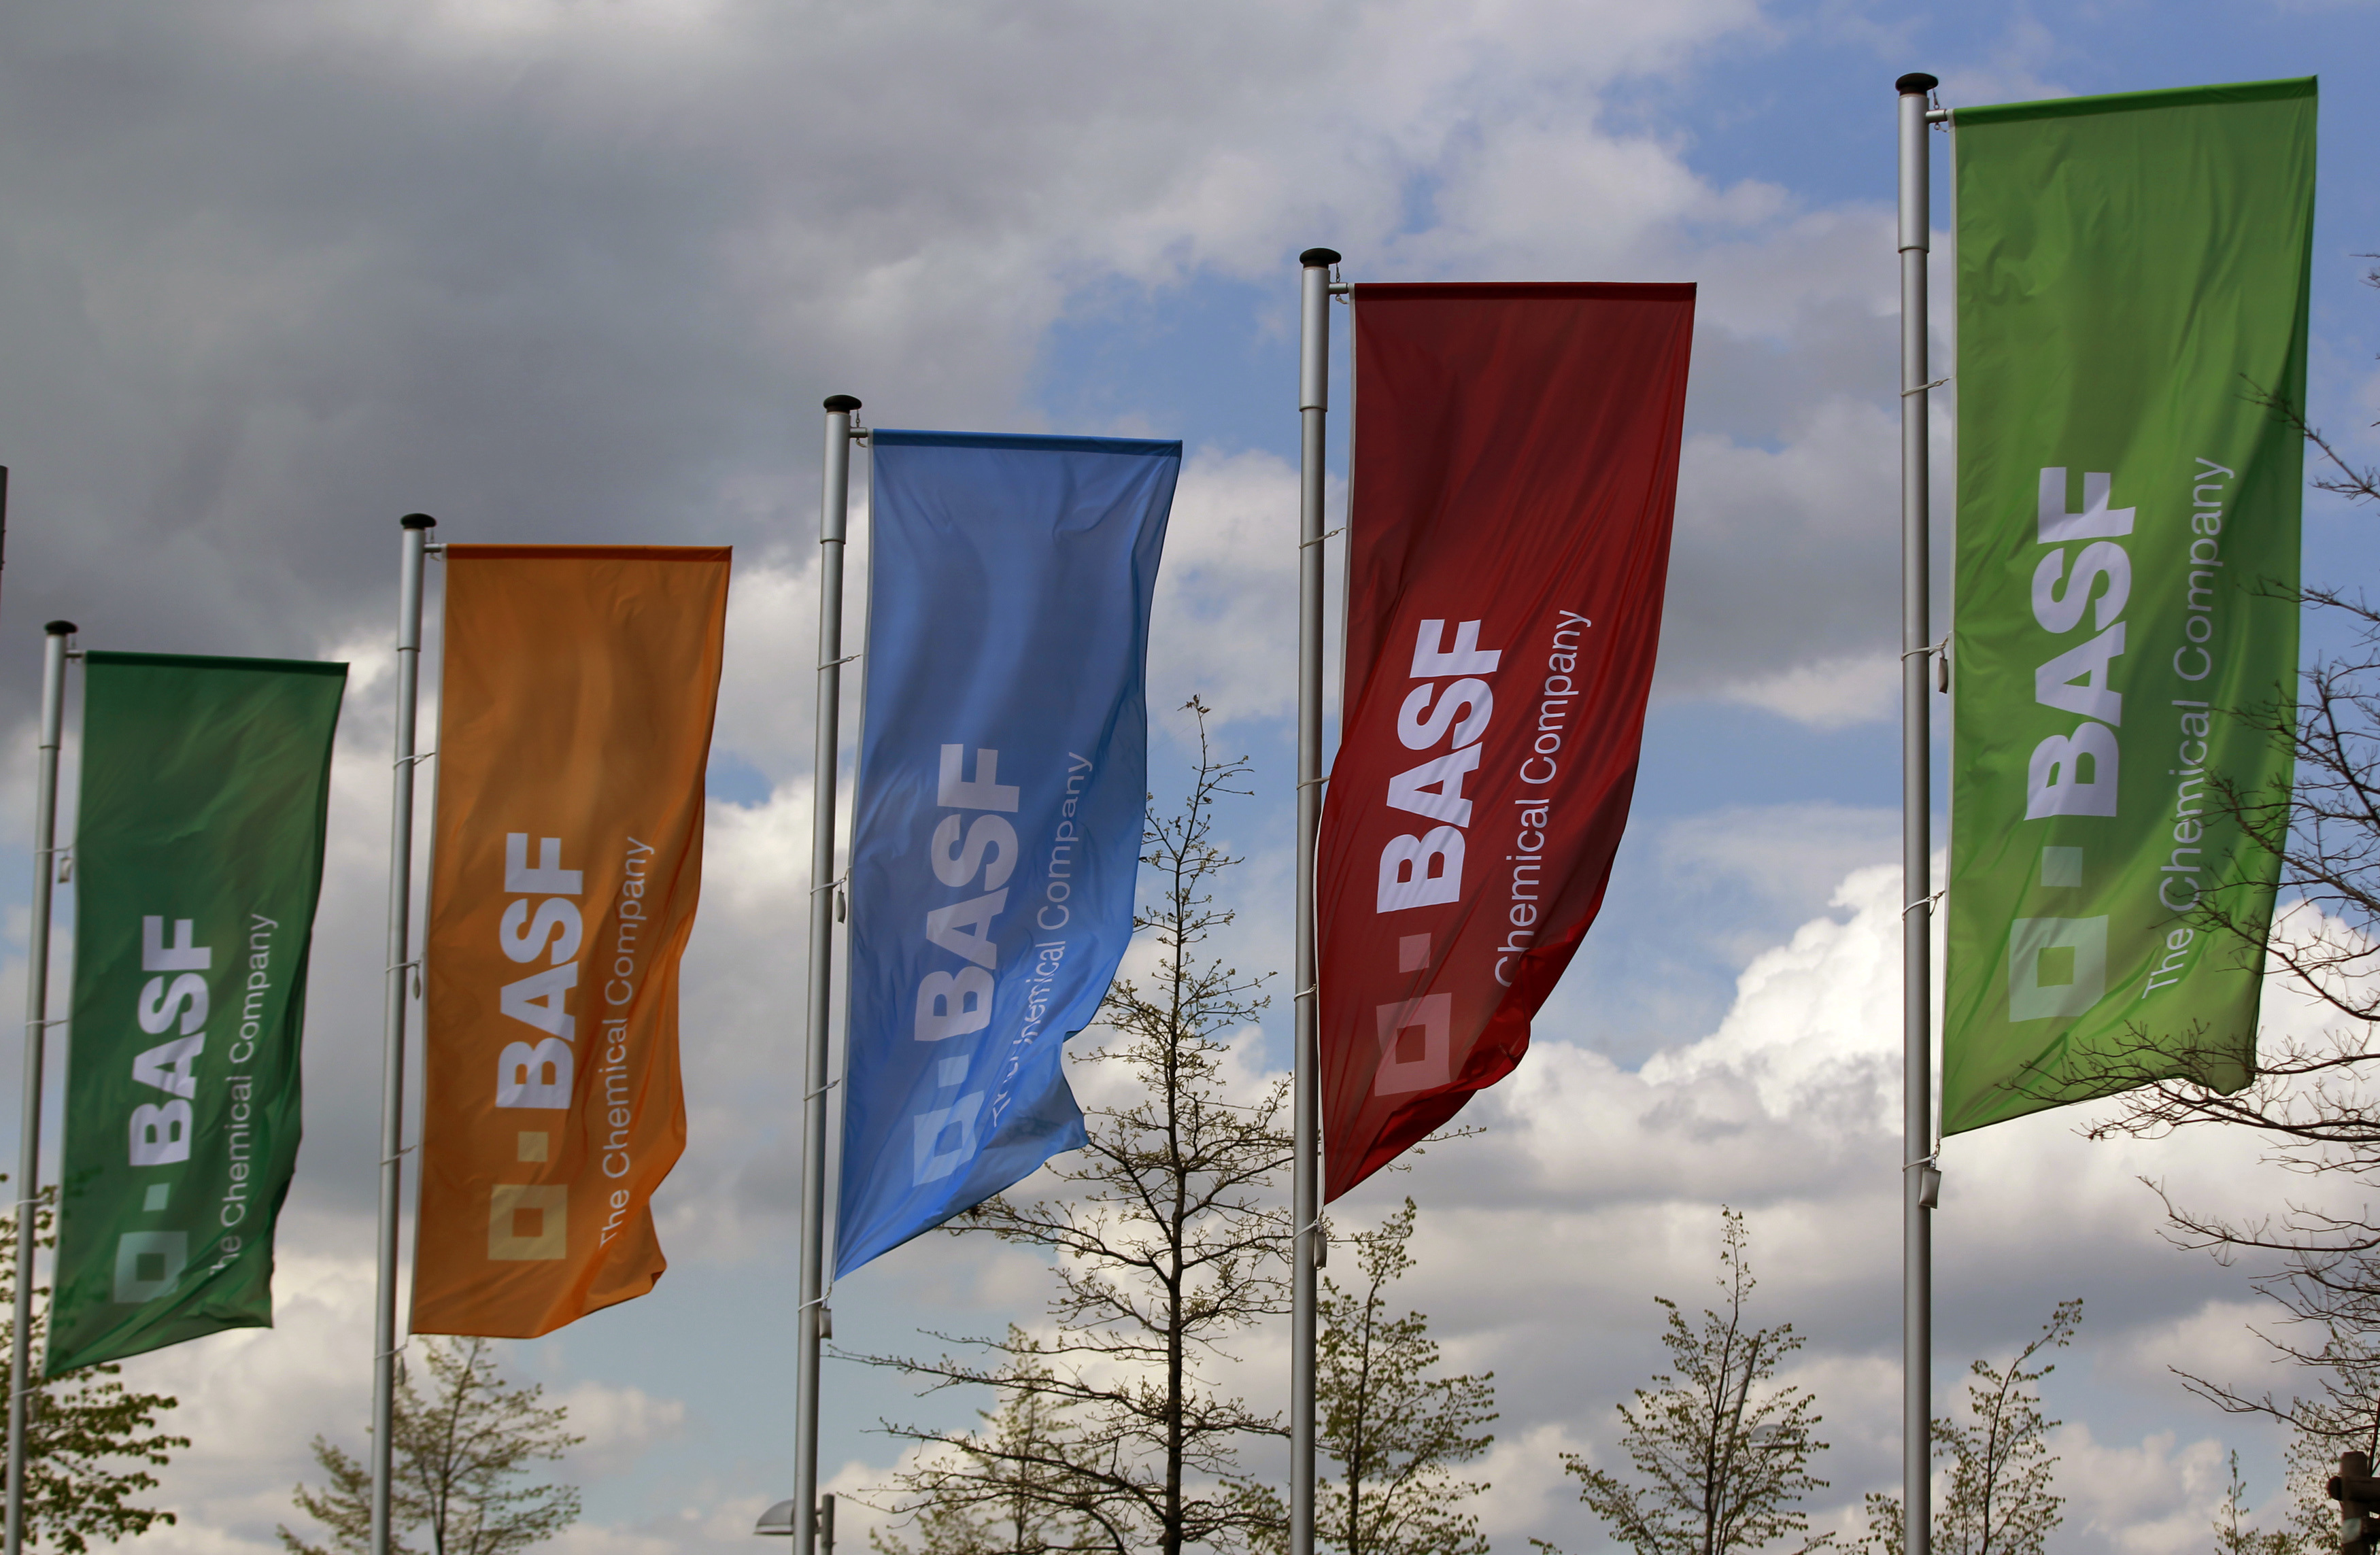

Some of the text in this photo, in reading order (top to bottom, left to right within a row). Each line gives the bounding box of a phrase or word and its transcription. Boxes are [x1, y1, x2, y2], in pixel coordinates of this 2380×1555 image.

[1377, 619, 1501, 913] BASF
[1495, 611, 1591, 985] Chemical Company
[2025, 467, 2136, 820] BASF
[2143, 458, 2234, 998] The Chemical Company
[496, 833, 582, 1109] BASF
[914, 744, 1020, 1042] BASF
[1036, 752, 1092, 930] Company
[129, 916, 211, 1166] BASF
[209, 913, 279, 1276] he Chemical Company
[598, 837, 654, 1249] The Chemical Company
